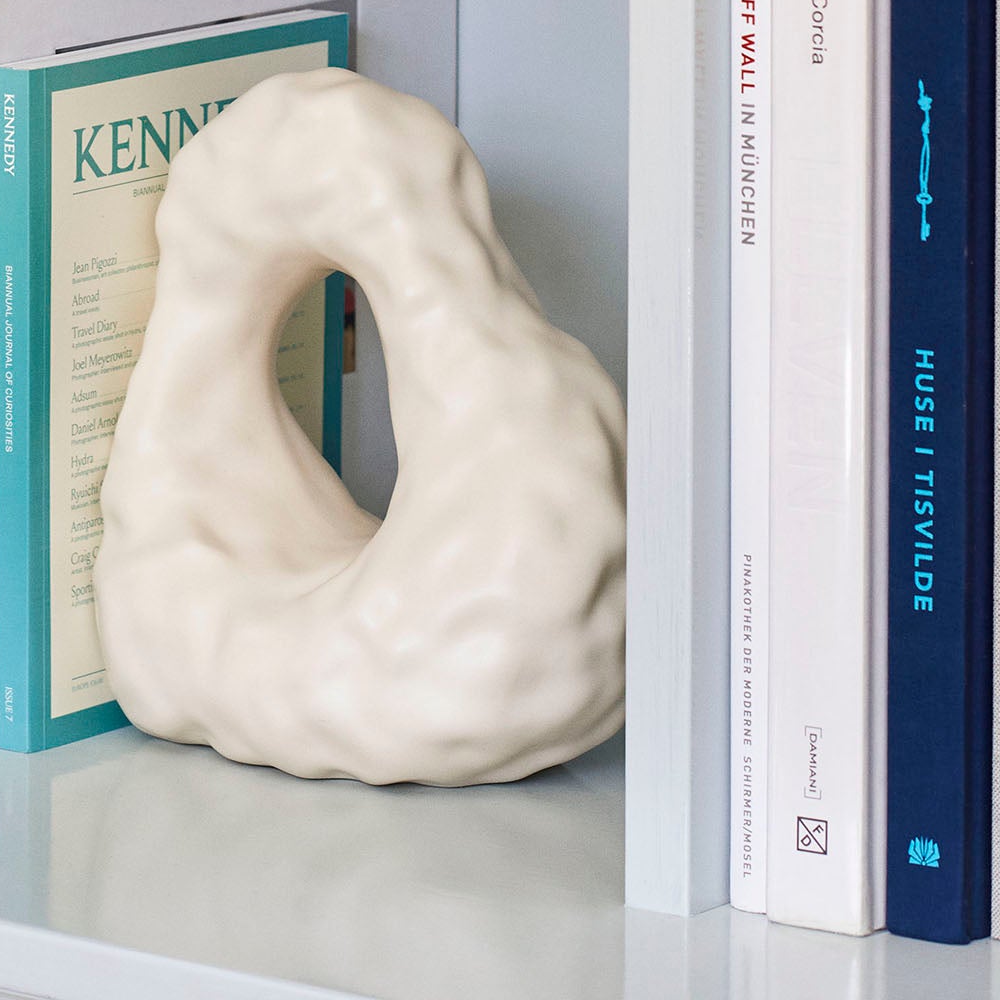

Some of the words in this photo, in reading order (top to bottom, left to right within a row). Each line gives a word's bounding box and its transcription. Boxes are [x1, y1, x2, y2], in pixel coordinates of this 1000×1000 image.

[741, 33, 756, 94] WALL
[4, 94, 16, 177] KENNEDY
[73, 97, 239, 183] KENN
[741, 103, 756, 126] IN
[741, 134, 760, 246] MÜNCHEN
[4, 265, 14, 318] BIANNUAL
[72, 262, 90, 275] Jean
[72, 289, 100, 307] Abroad
[4, 319, 14, 369] JOURNAL
[72, 322, 95, 339] Travel
[97, 319, 119, 334] Diary
[4, 371, 14, 385] OF
[72, 357, 88, 372] Joel
[914, 349, 934, 433] HUSE
[4, 387, 14, 453] CURIOSITIES
[72, 418, 96, 437] Daniel
[914, 447, 934, 455] I
[914, 470, 934, 612] TISVILDE
[743, 553, 752, 642] PINAKOTHEK
[743, 648, 752, 674] DER
[743, 679, 752, 746] MODERNE
[809, 733, 817, 793] DAMIANI
[743, 756, 752, 879] SCHIRMER/MOSEL
